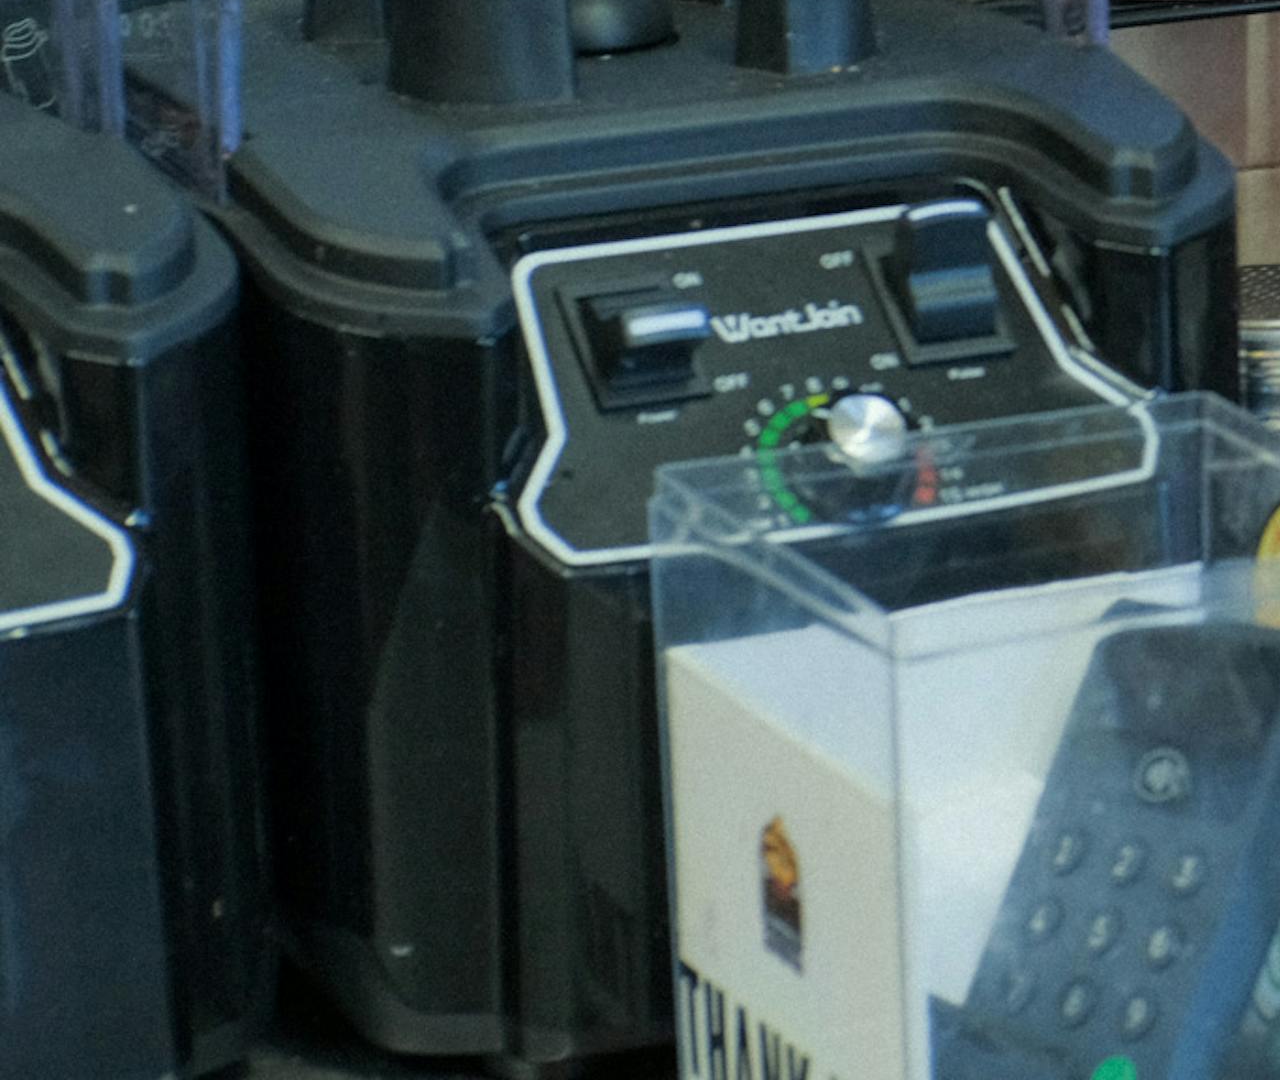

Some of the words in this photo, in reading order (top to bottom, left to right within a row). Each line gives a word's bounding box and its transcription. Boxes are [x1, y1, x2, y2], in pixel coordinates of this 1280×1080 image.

[819, 250, 854, 270] OFF
[672, 272, 703, 290] ON
[869, 352, 899, 371] ON
[713, 372, 750, 393] OFF
